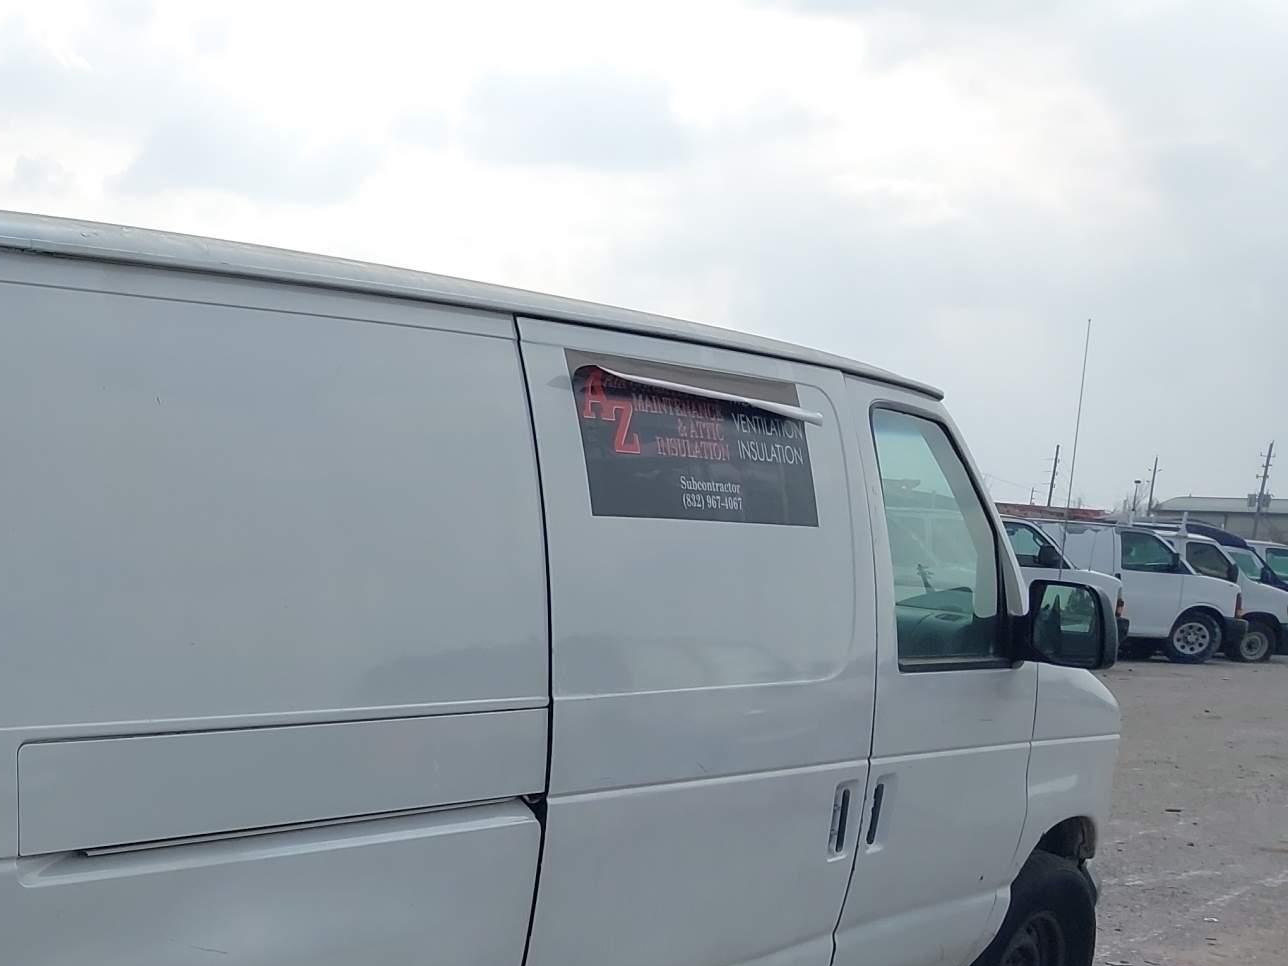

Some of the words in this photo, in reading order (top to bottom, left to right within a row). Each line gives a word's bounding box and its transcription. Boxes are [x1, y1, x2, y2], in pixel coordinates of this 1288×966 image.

[631, 394, 724, 422] MAINTENANCE
[688, 422, 724, 442] ATTIC
[732, 413, 803, 440] VENTILATION
[656, 436, 730, 461] INSULATION
[738, 439, 804, 465] INSULATION
[680, 475, 741, 494] Subcontractor
[682, 493, 705, 510] (832)
